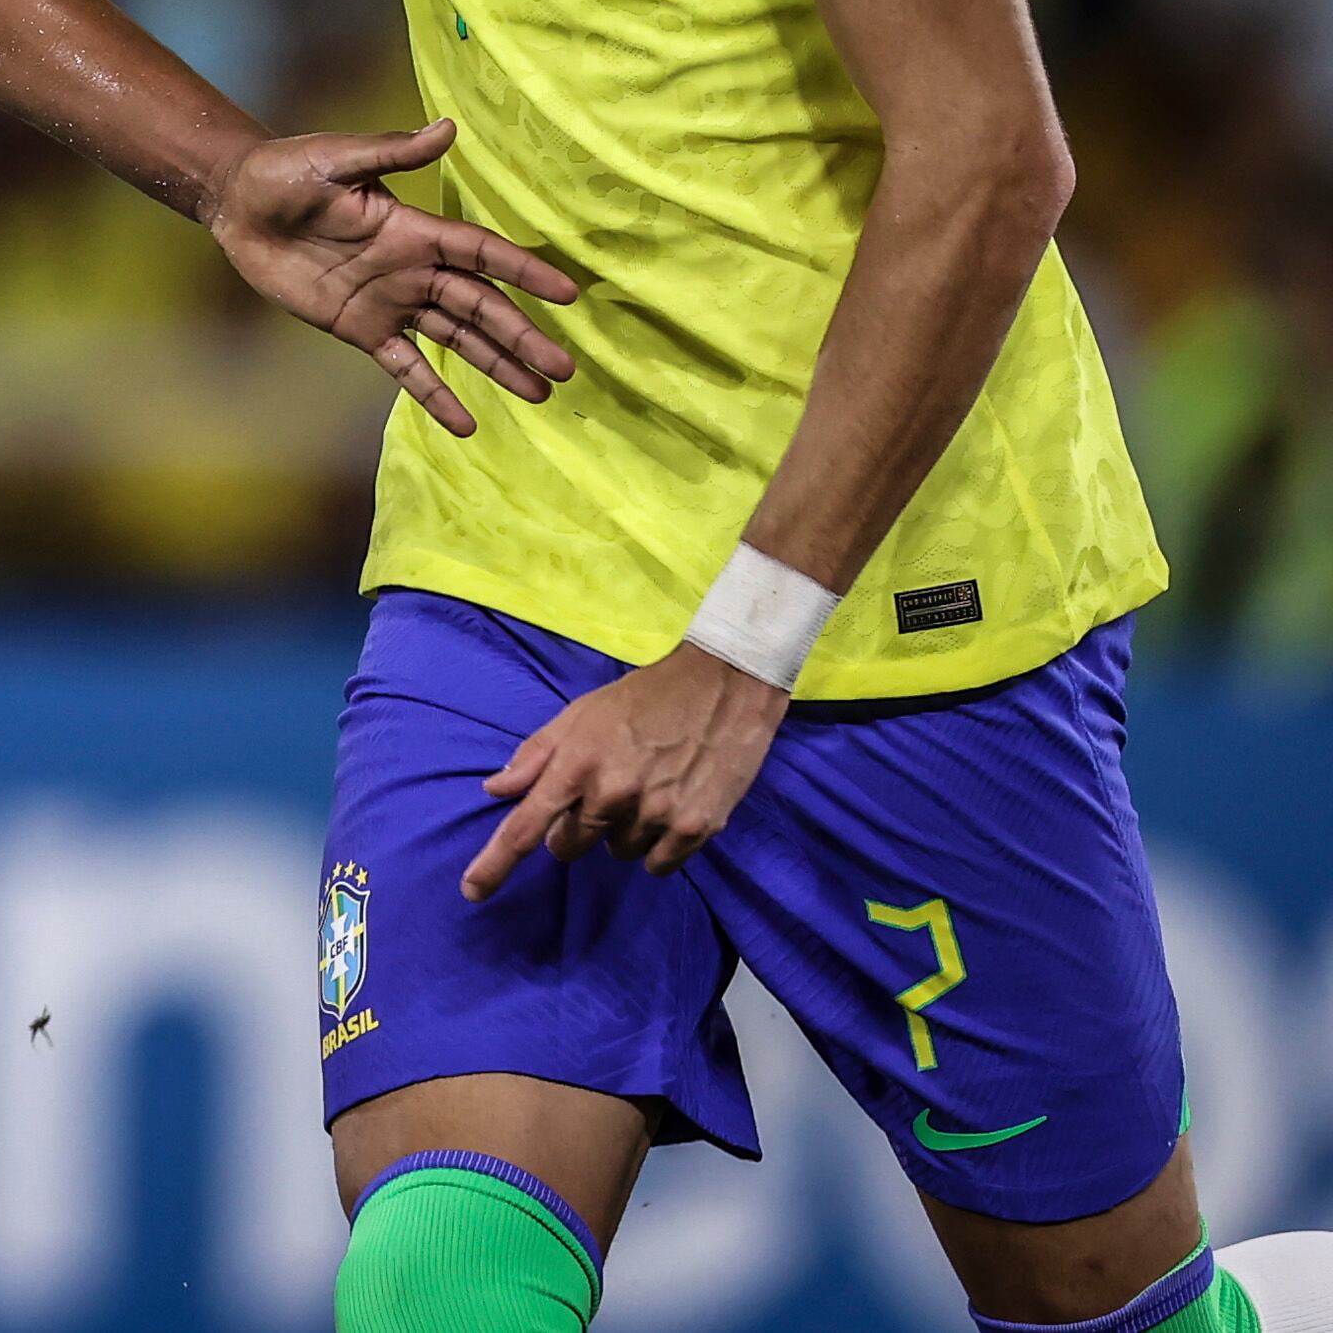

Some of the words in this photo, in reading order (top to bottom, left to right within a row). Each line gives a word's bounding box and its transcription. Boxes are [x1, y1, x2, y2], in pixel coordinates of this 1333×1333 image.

[329, 935, 350, 959] CBF
[864, 897, 968, 1072] 7
[322, 1007, 381, 1061] BRASIL
